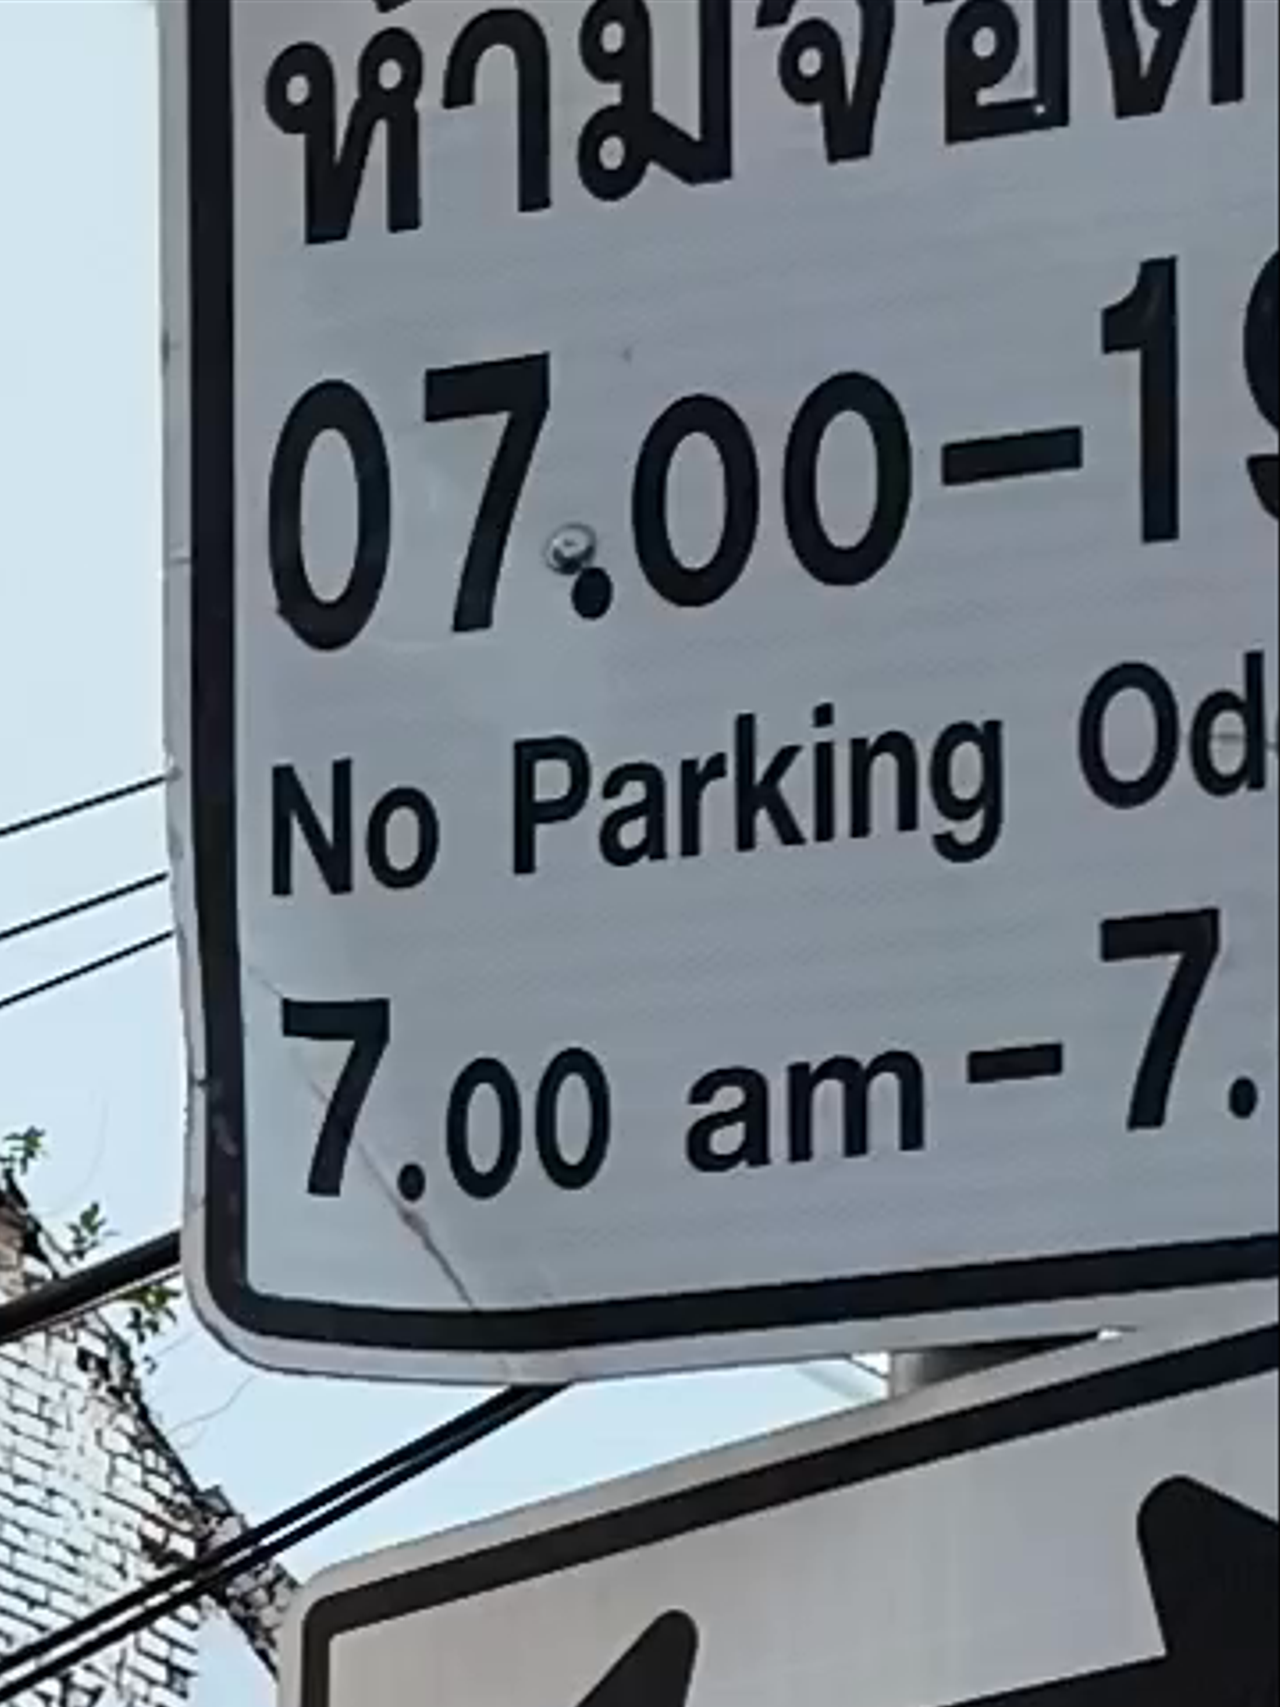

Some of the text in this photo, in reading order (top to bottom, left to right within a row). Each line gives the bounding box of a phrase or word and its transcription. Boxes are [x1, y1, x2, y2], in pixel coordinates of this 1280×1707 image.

[265, 0, 1244, 244] หามจอด
[271, 758, 439, 896] No
[512, 703, 1005, 875] Parking
[281, 998, 611, 1200] 7.00
